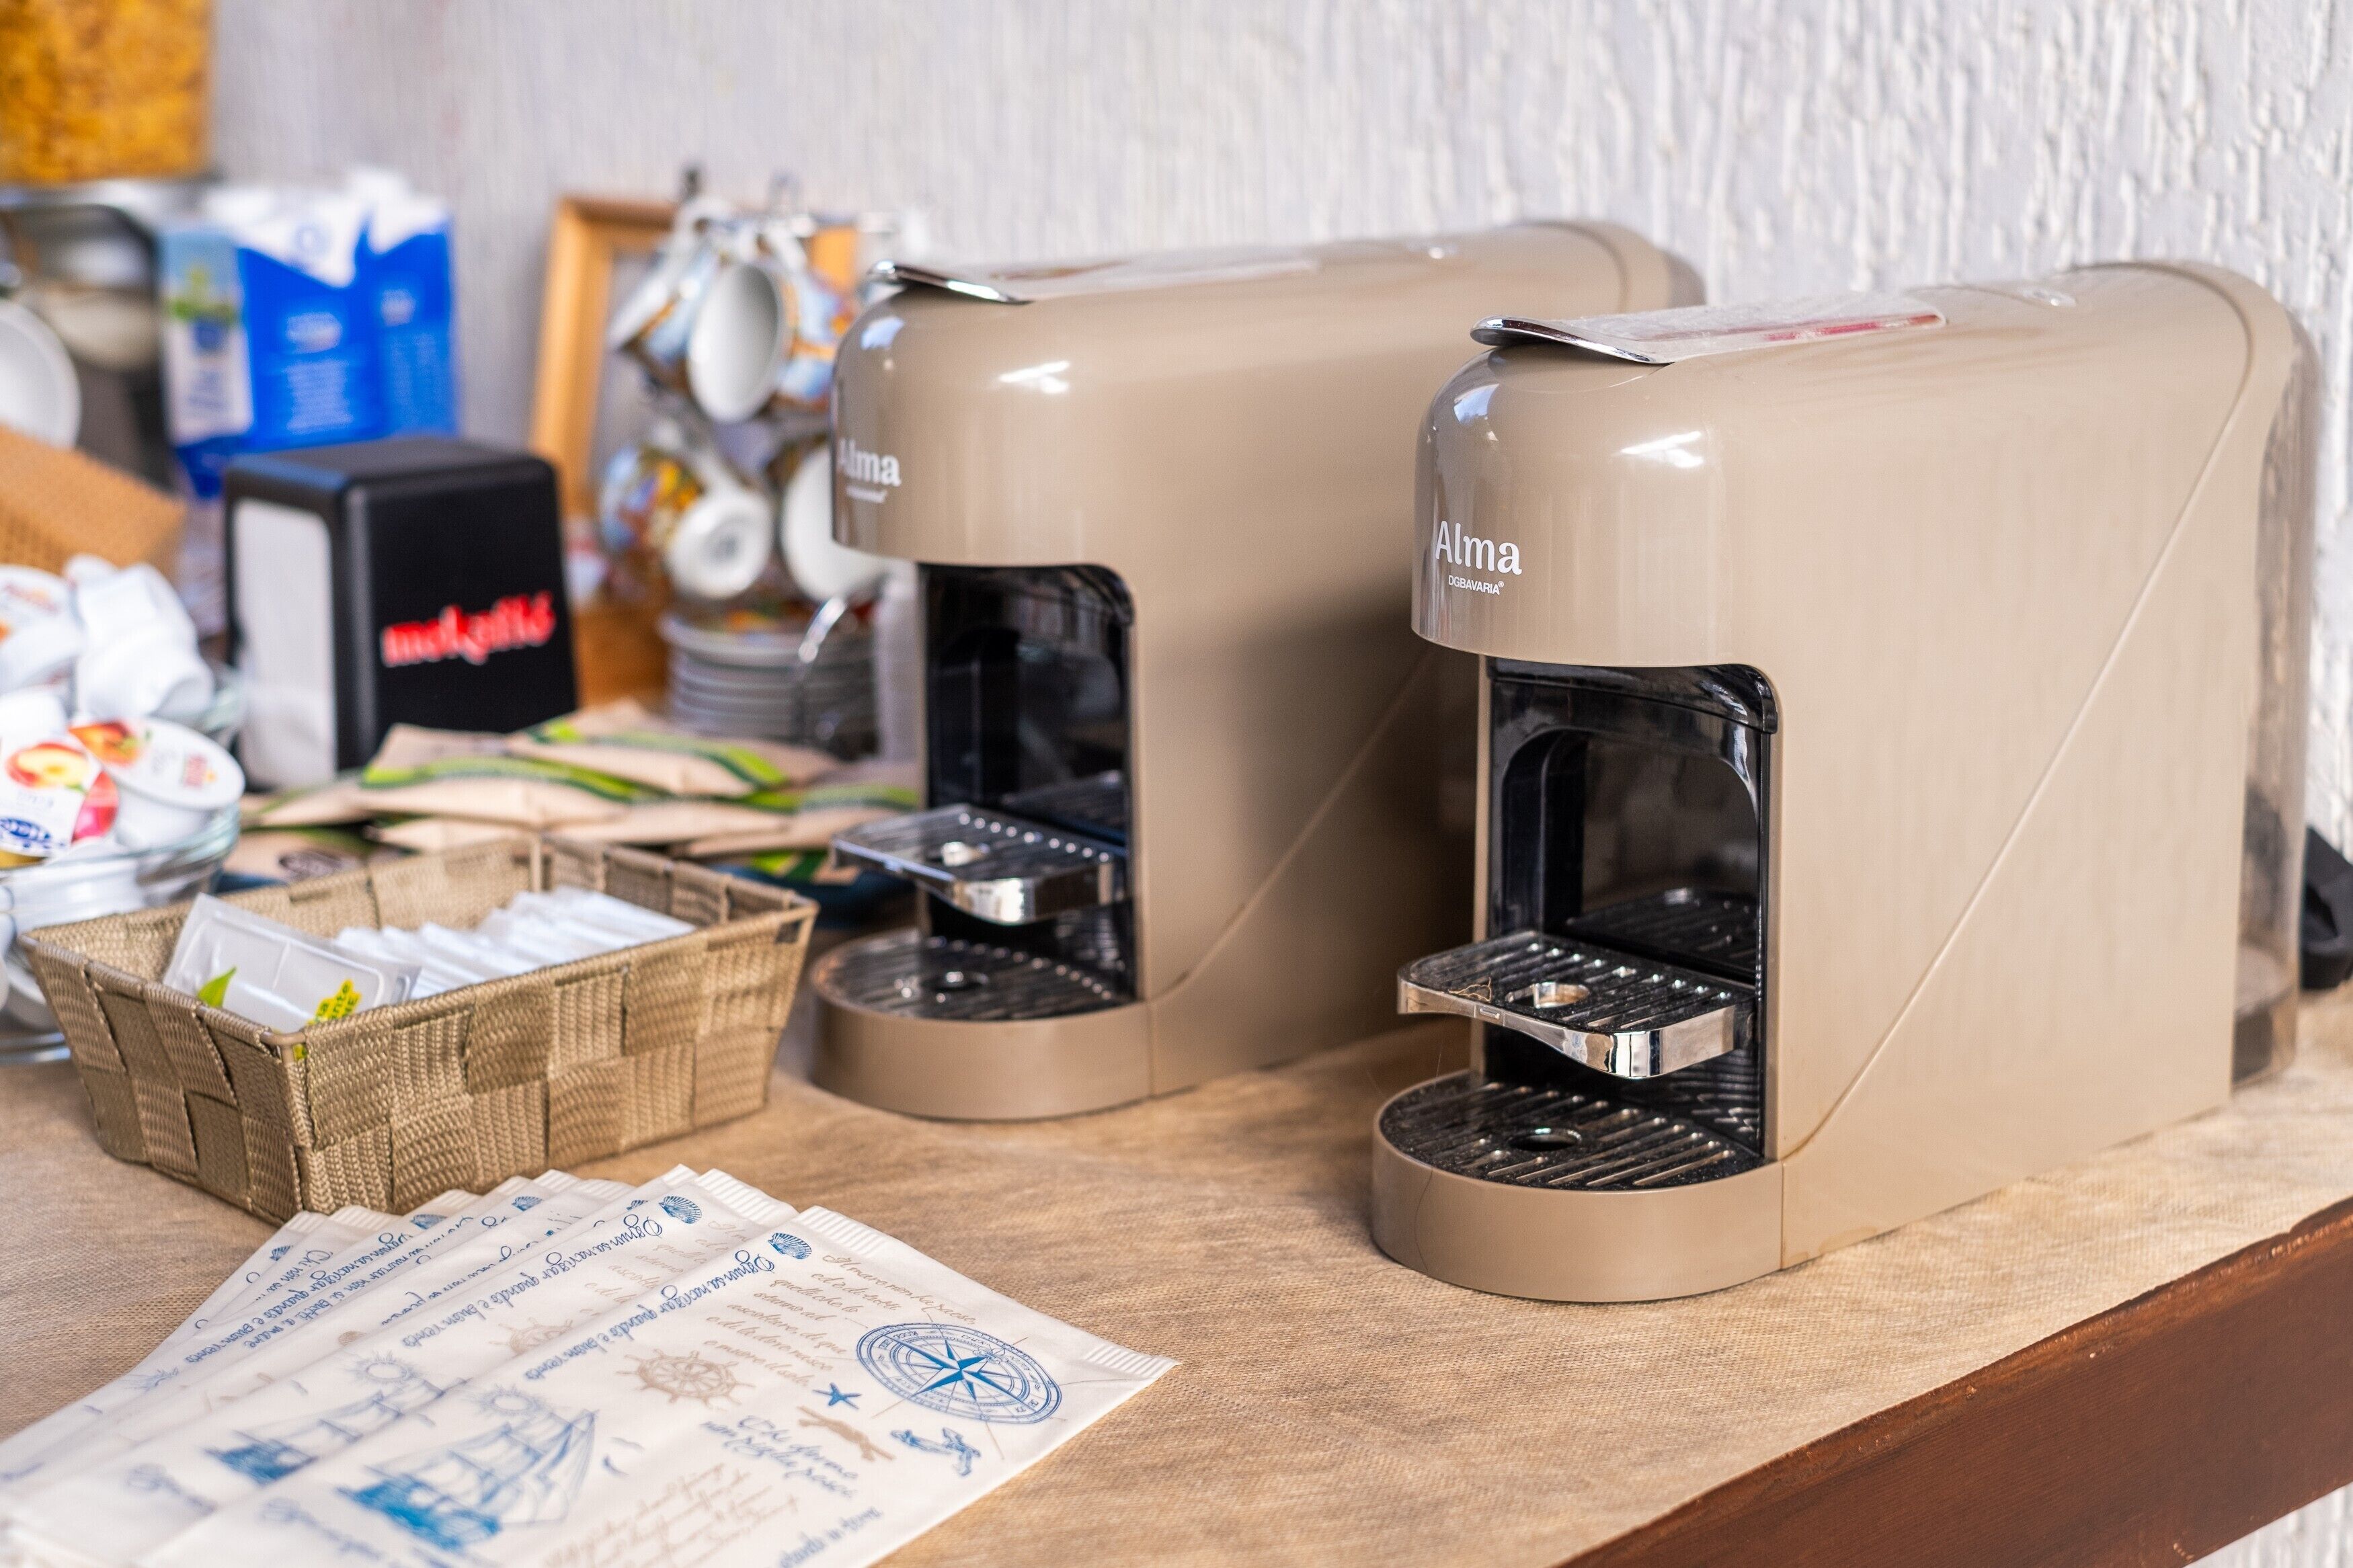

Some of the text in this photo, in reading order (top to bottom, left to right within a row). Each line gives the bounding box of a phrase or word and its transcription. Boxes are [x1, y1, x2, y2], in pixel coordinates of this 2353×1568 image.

[838, 438, 902, 487] Alma
[1435, 520, 1522, 575] Alma
[610, 1214, 662, 1245] Ognun
[298, 1250, 333, 1268] Chi
[592, 1242, 612, 1253] sa
[281, 1268, 303, 1282] non
[543, 1249, 596, 1279] navigar
[723, 1250, 774, 1281] Ognun
[490, 1272, 540, 1308] quando
[707, 1276, 727, 1289] sa
[846, 1267, 887, 1285] mare
[885, 1284, 913, 1296] non
[911, 1294, 934, 1305] ha
[660, 1284, 711, 1313] navigar
[812, 1296, 843, 1307] che
[442, 1304, 486, 1325] buon
[610, 1304, 657, 1341] quando
[800, 1311, 838, 1320] ad
[243, 1325, 284, 1348] mare
[402, 1323, 446, 1347] vento
[563, 1337, 608, 1358] buon
[524, 1356, 568, 1380] vento
[699, 1421, 737, 1438] non
